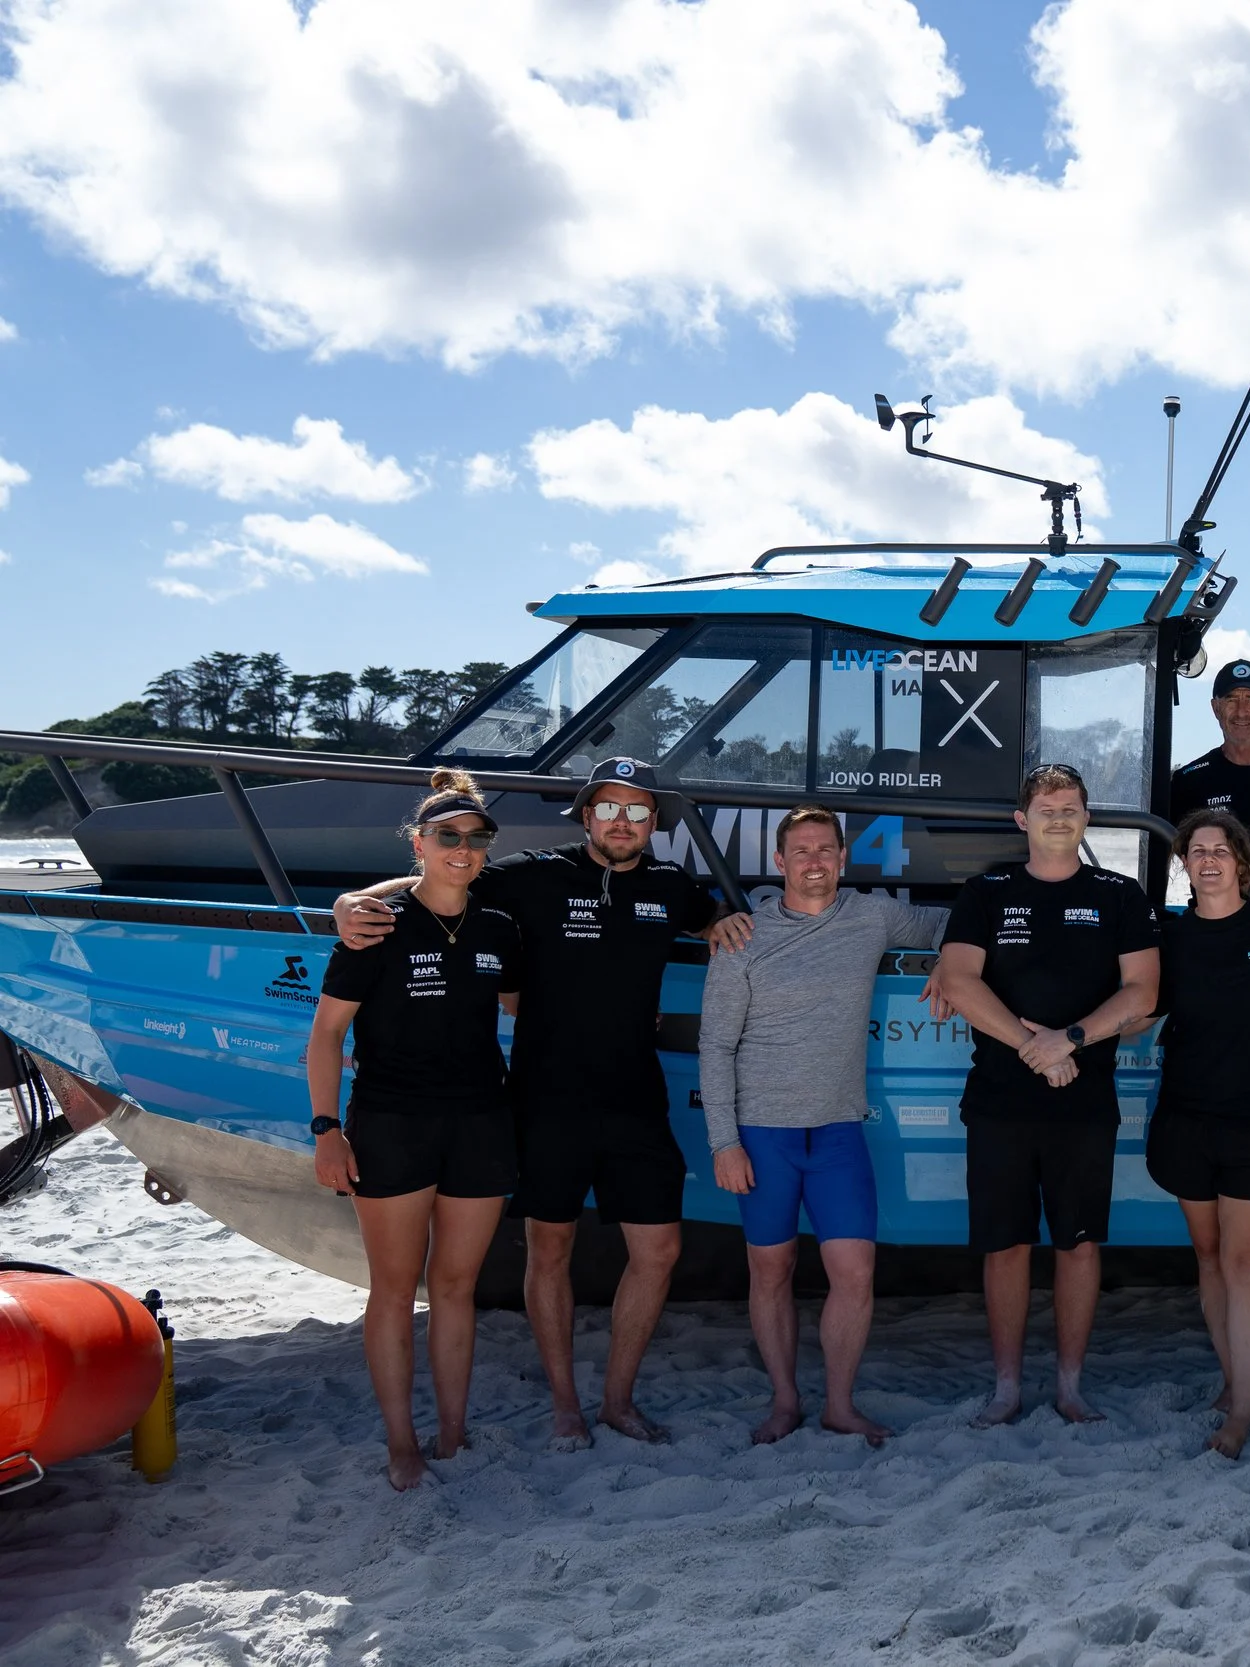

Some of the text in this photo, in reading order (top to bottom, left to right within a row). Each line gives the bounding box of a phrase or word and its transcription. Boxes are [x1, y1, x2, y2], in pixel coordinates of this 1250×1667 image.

[827, 772, 942, 787] JONO RIDLER
[1064, 907, 1099, 917] SWIM4
[565, 931, 600, 939] Generate
[420, 967, 439, 975] APL
[144, 1018, 179, 1035] Linkeight
[231, 1036, 280, 1051] HEATPORT
